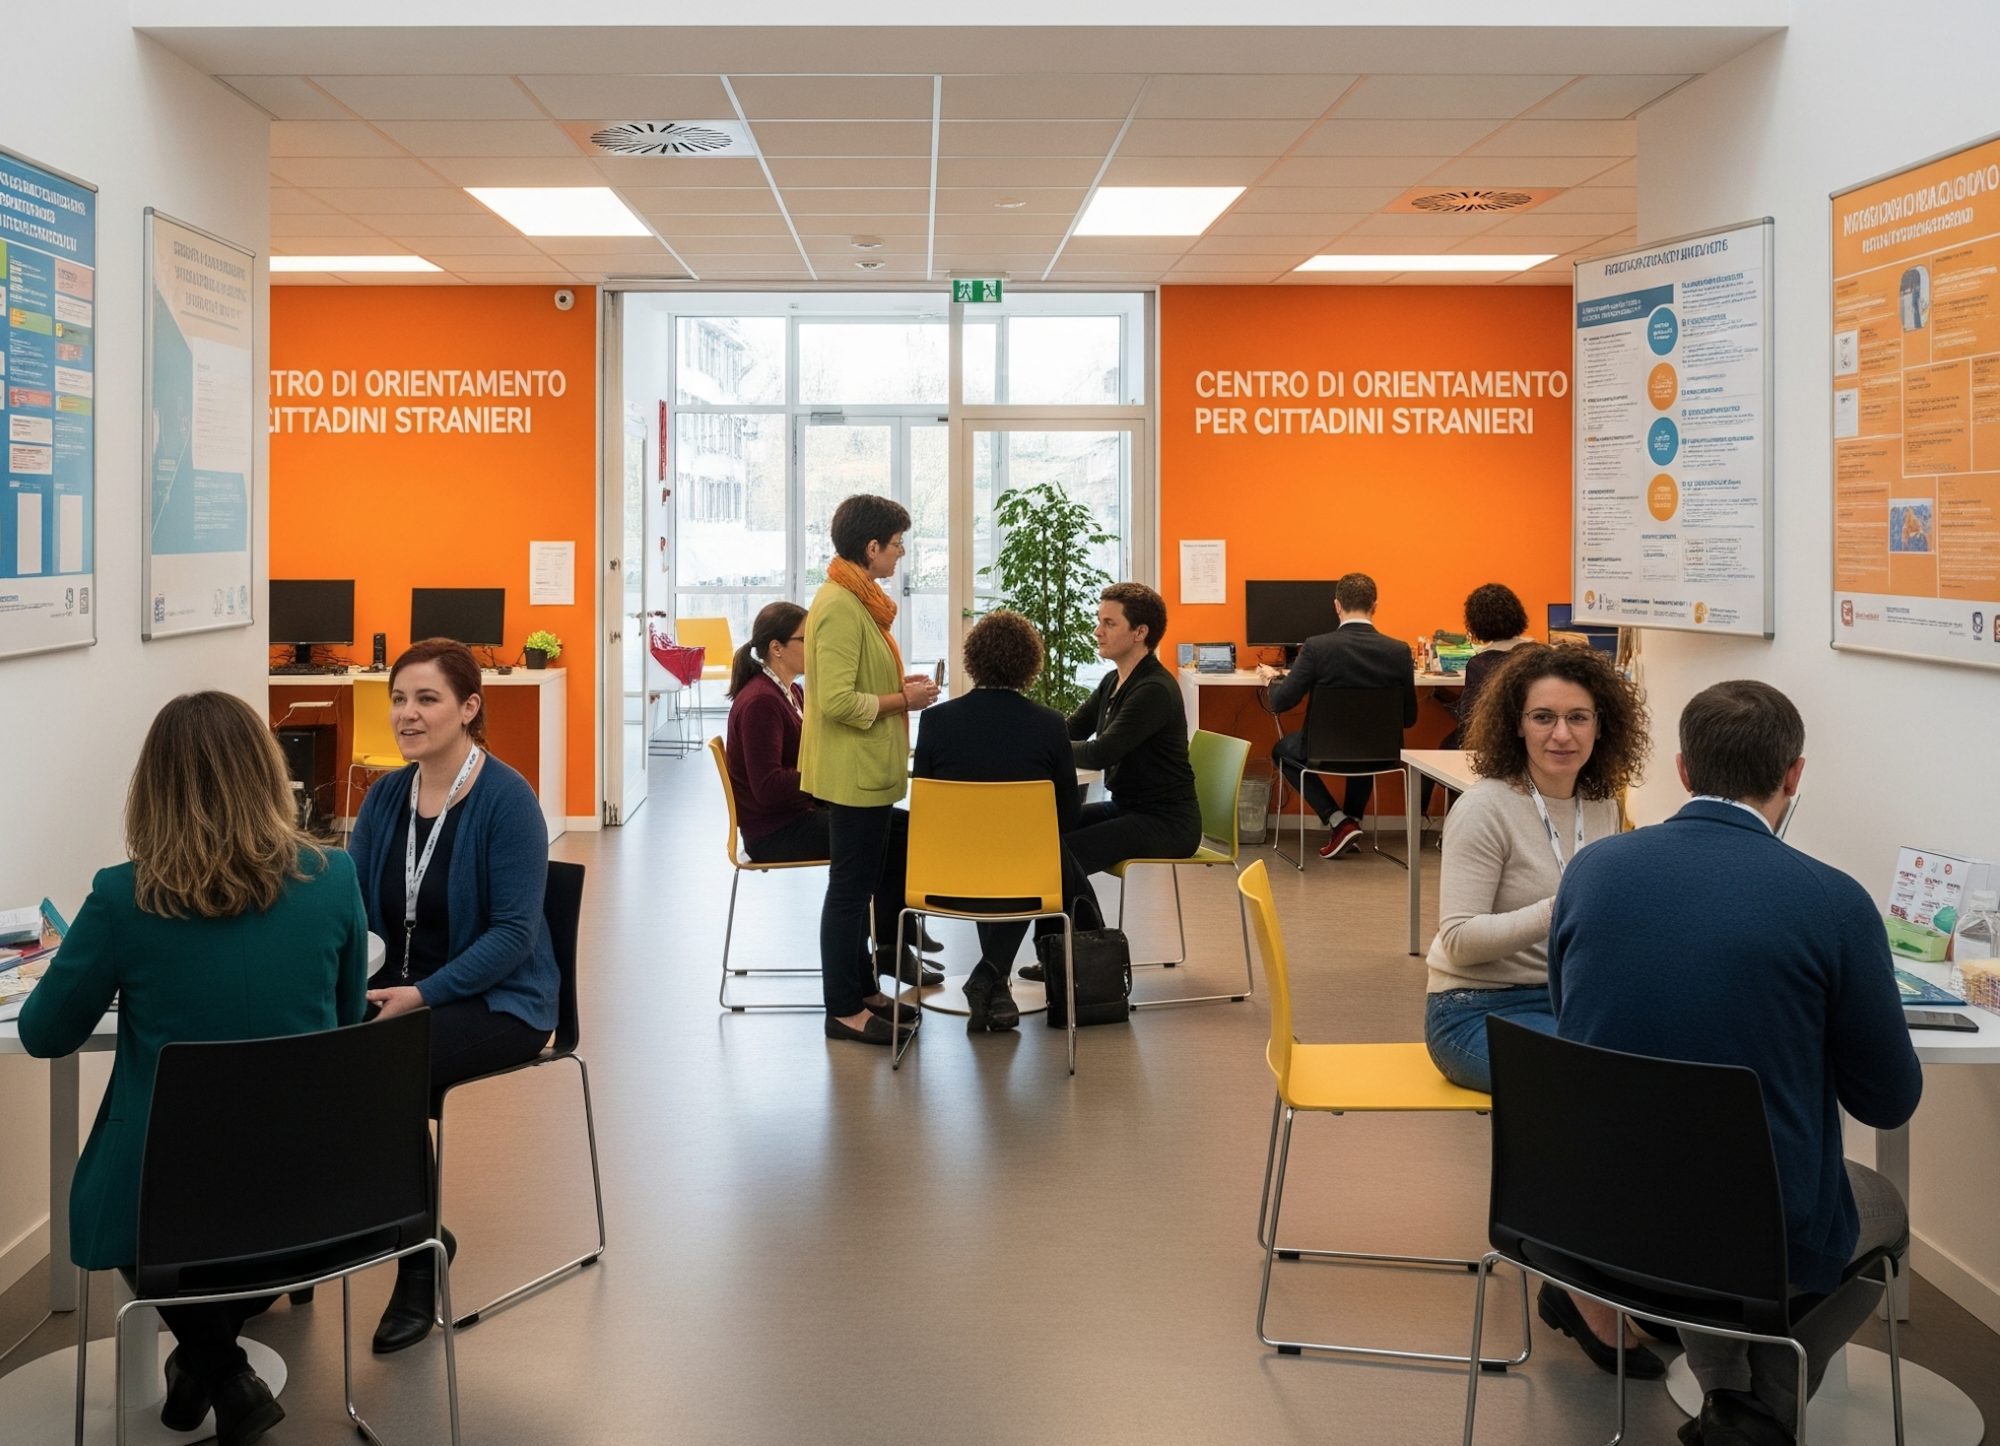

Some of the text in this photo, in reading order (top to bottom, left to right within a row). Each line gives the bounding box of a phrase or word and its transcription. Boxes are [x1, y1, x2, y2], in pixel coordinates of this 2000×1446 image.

[269, 369, 566, 397] TRO DI ORIENTAMENTO
[1196, 370, 1568, 398] CENTRO DI ORIENTAMENTO
[395, 406, 531, 434] STRANIERI
[1195, 407, 1533, 435] PER CITTADINI STRANIERI
